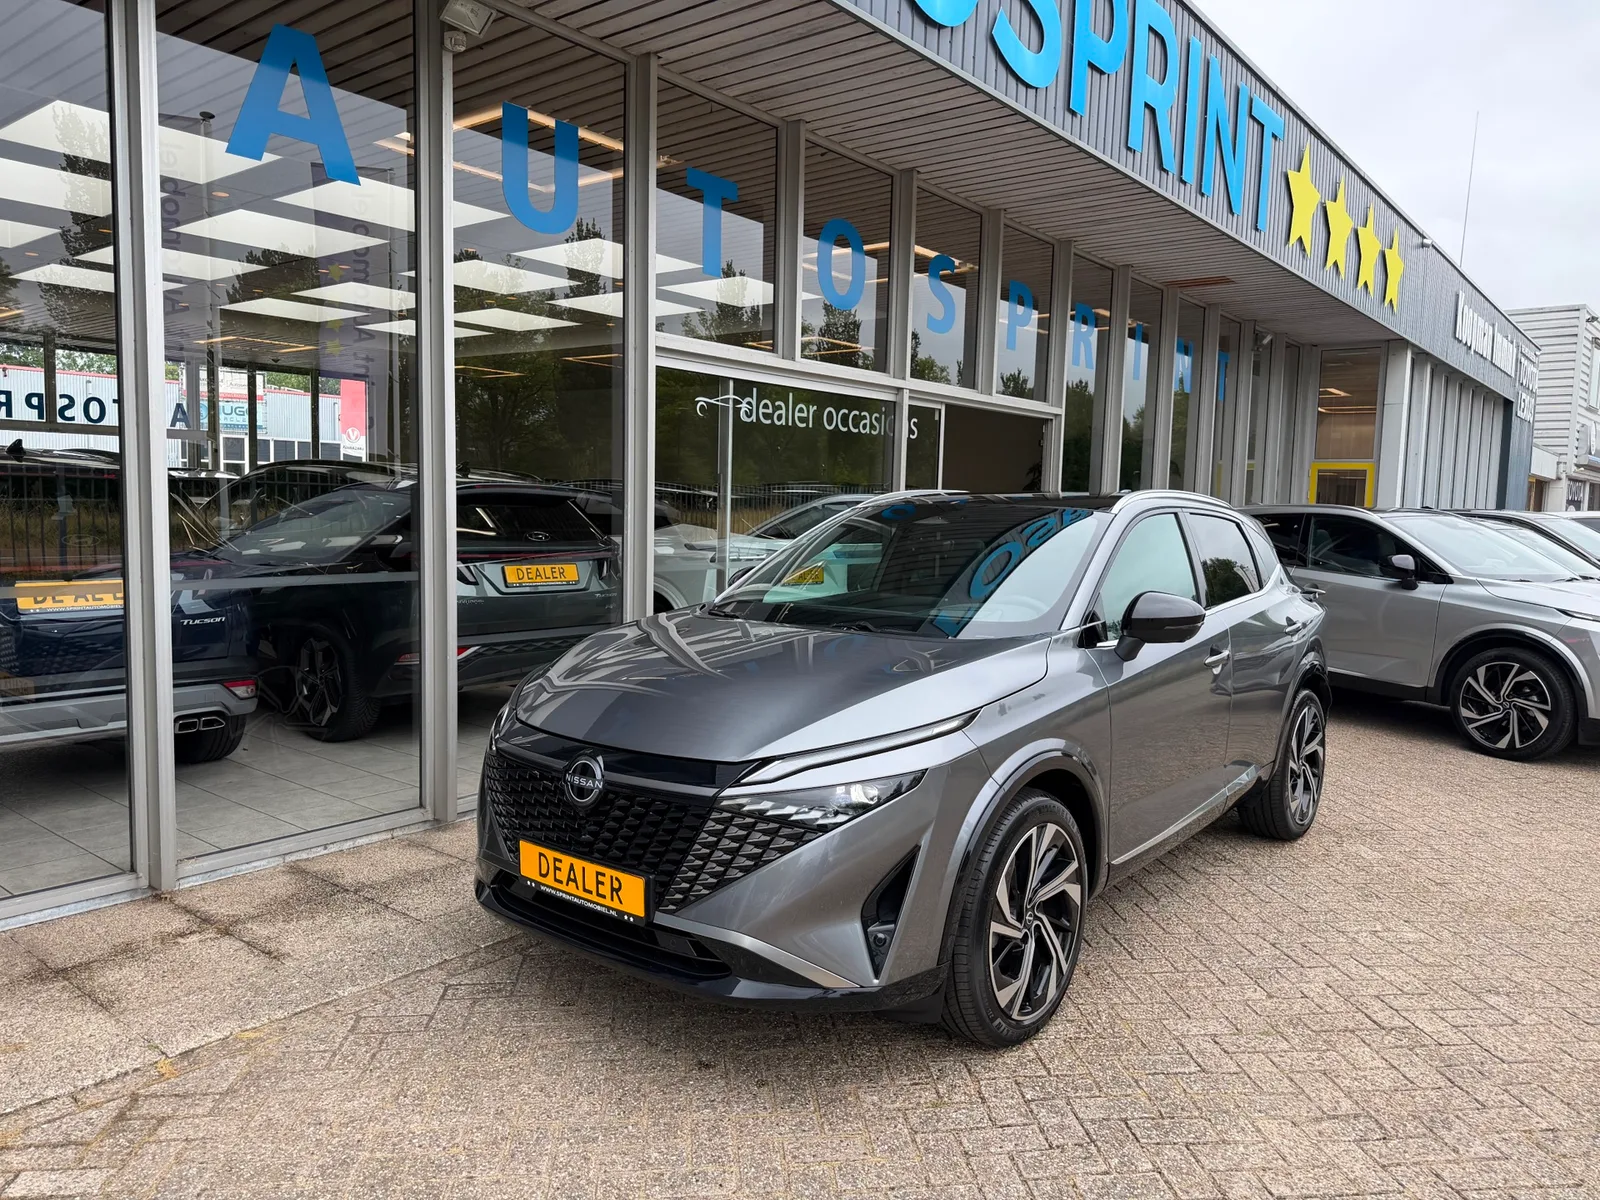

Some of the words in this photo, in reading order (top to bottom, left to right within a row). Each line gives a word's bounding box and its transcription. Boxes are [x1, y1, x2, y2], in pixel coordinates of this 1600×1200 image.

[740, 387, 817, 428] dealer
[516, 567, 566, 580] DEALER
[566, 773, 602, 788] NISSAN
[538, 851, 623, 905] DEALER
